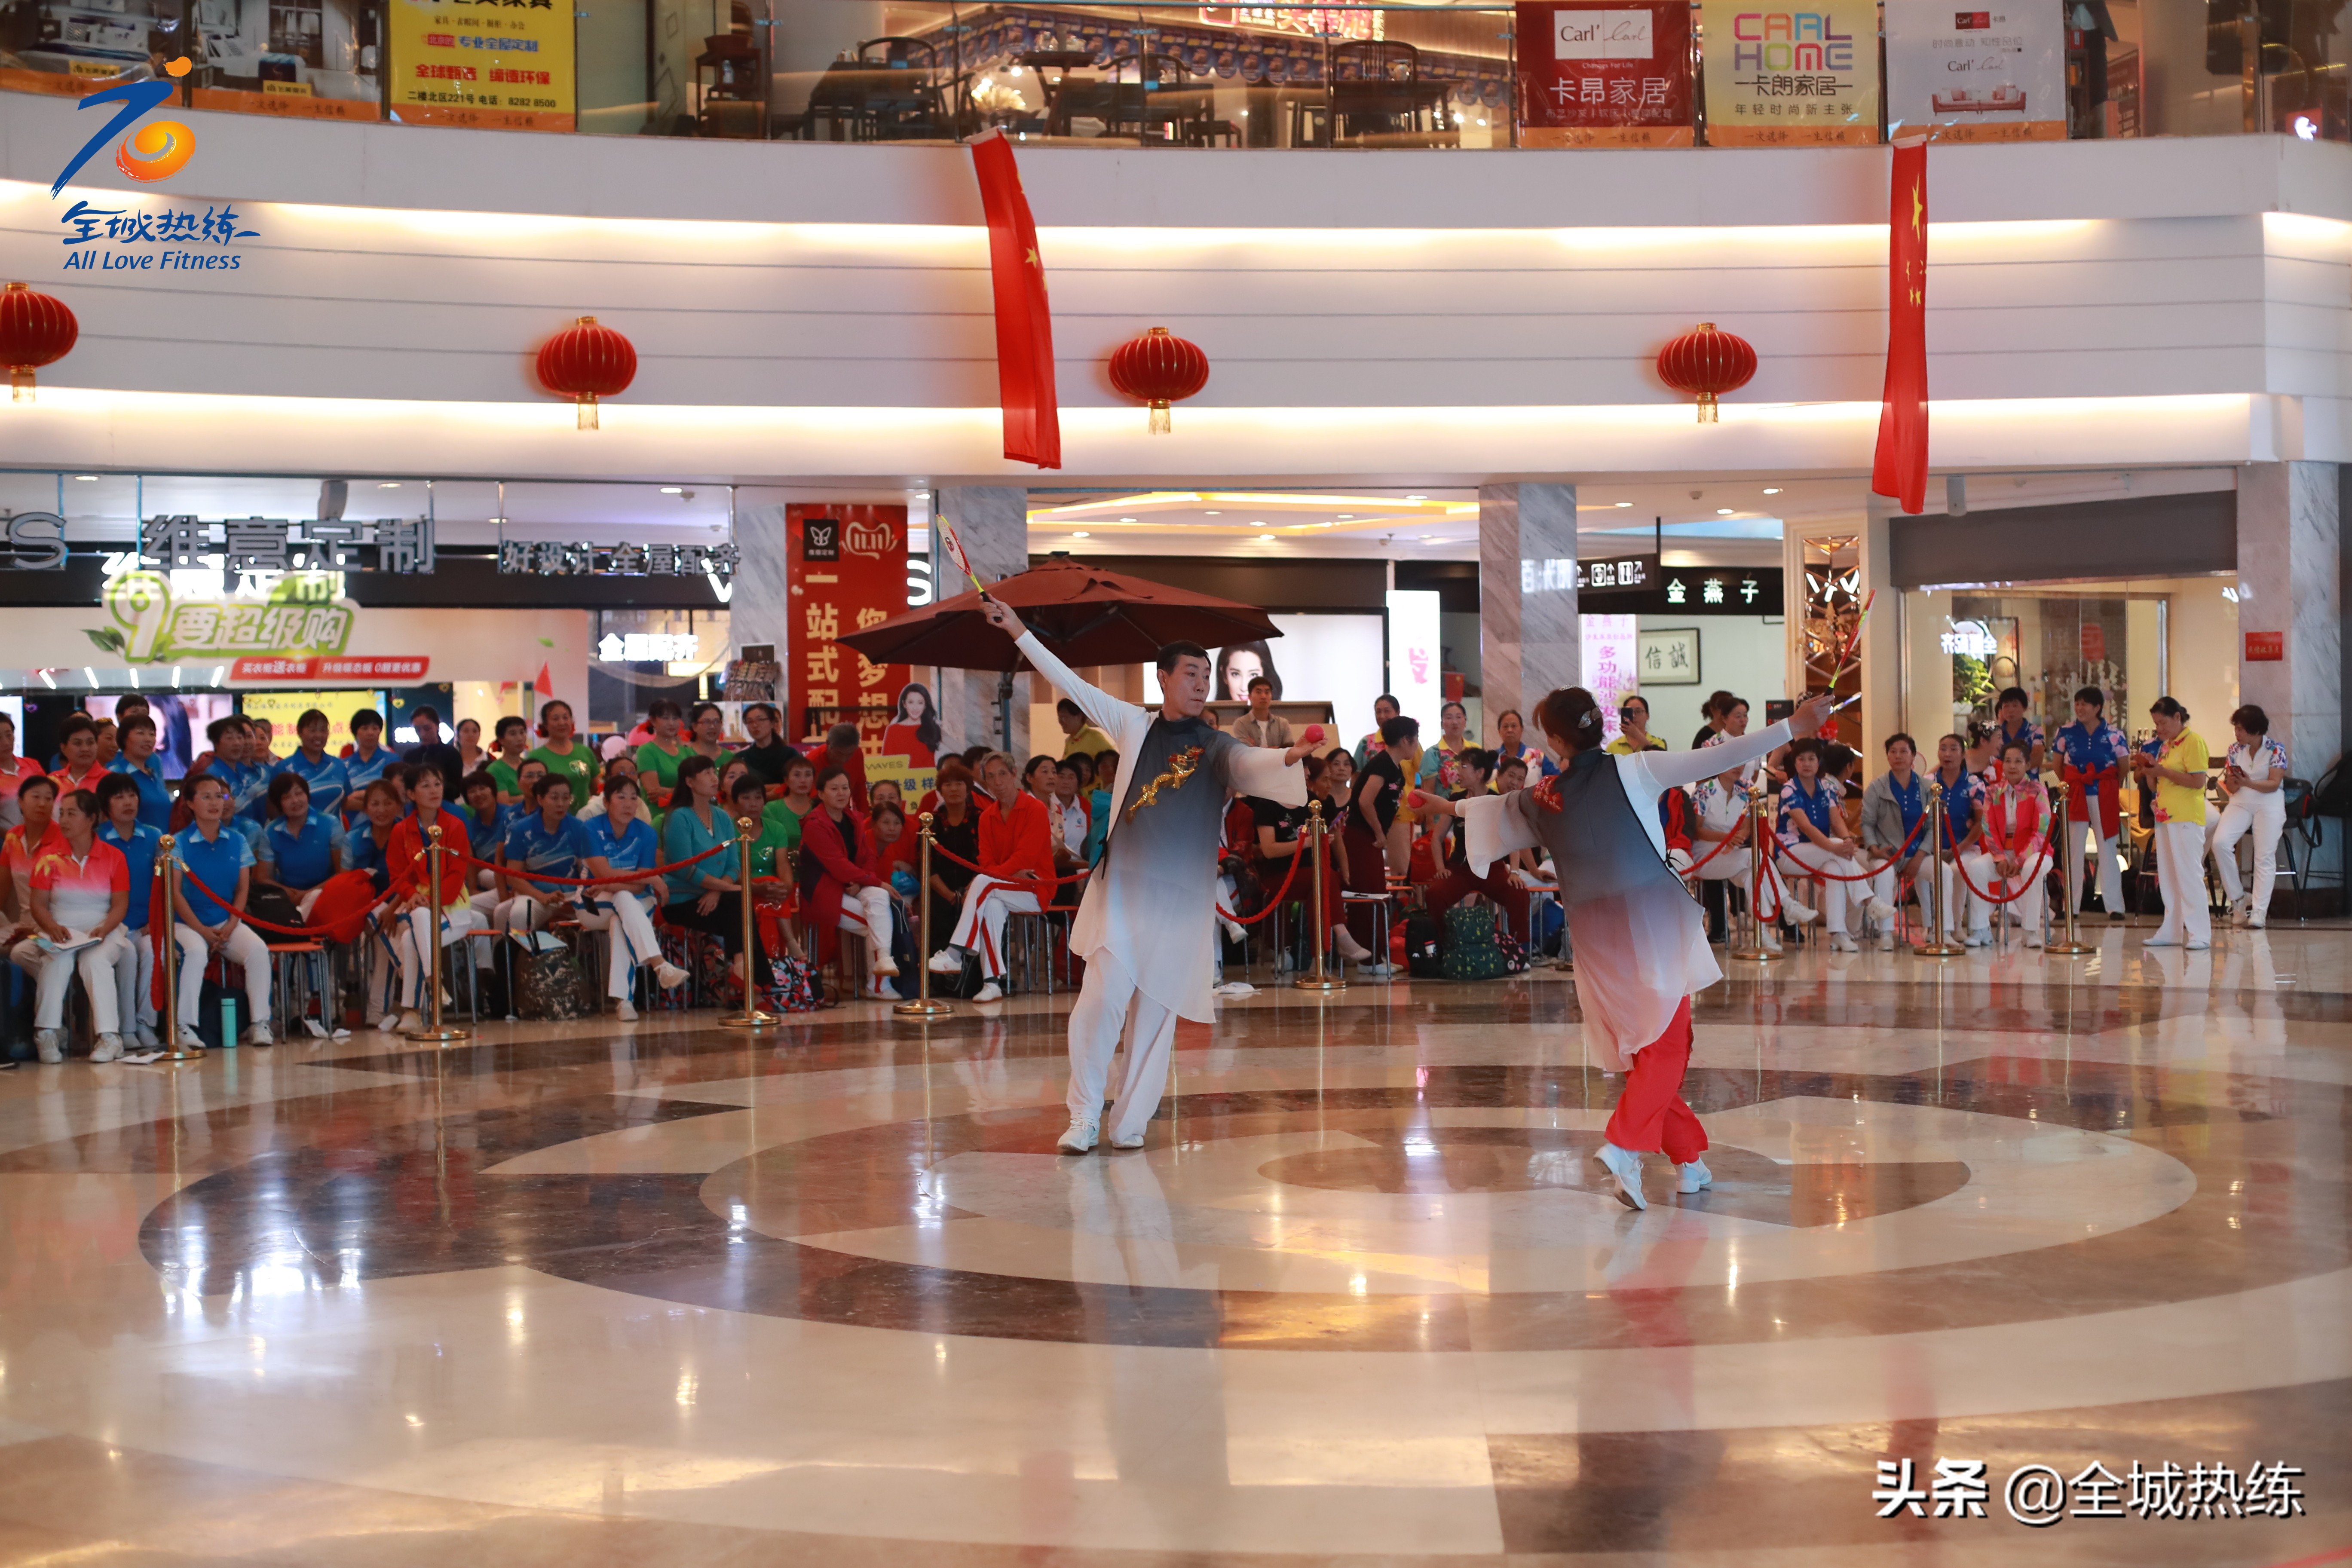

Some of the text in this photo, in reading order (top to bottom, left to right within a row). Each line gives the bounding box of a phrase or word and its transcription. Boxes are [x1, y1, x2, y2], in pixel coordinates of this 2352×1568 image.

[1734, 43, 1853, 70] HOME
[407, 91, 475, 104] 二楼北区221号
[508, 97, 530, 107] 8282
[533, 98, 556, 107] 8500
[1549, 77, 1669, 105] 卡昂家居
[1734, 103, 1853, 115] 年轻时尚新主张
[142, 515, 435, 574] 维意定制
[505, 541, 741, 575] 好设计 全屋配齐
[1666, 578, 1759, 603] 金燕子
